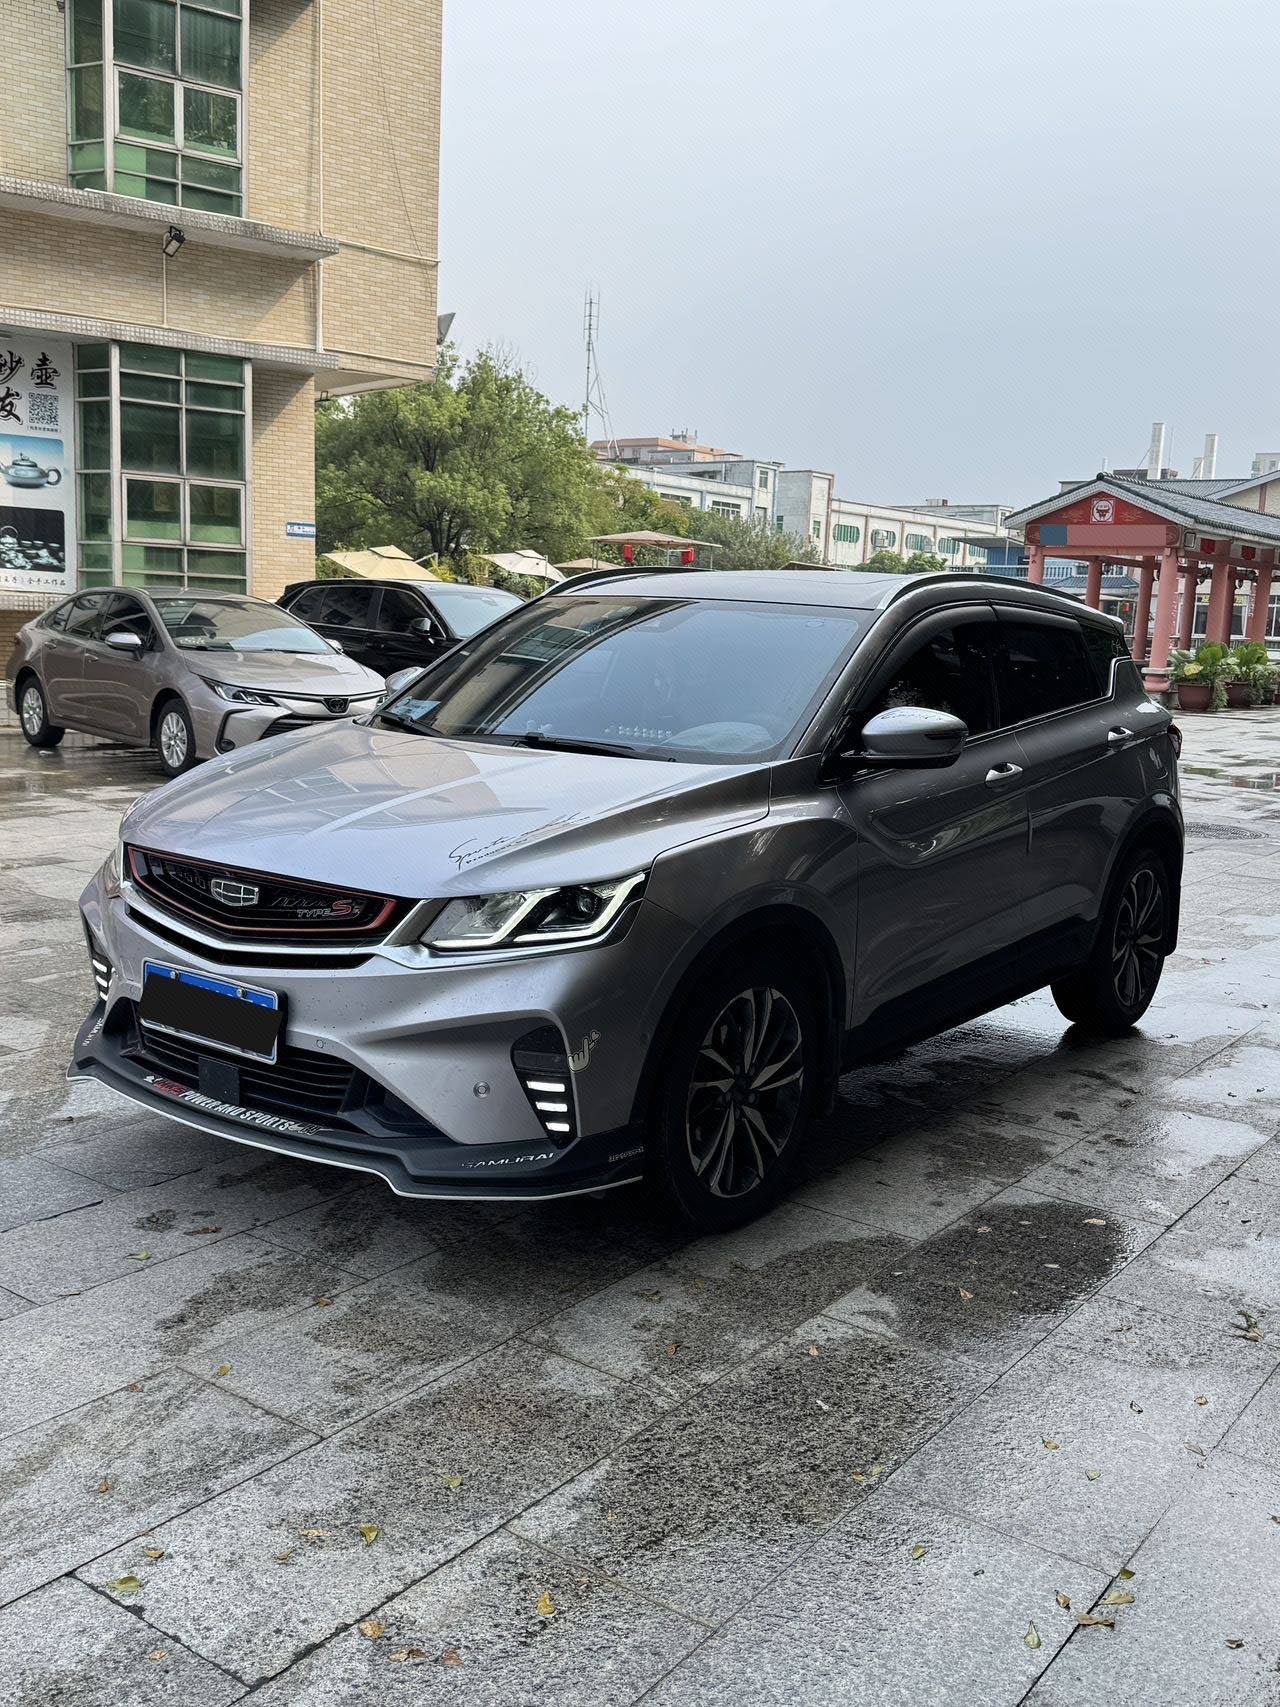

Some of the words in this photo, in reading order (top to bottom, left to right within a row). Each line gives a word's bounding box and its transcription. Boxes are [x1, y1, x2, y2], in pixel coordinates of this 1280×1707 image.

[297, 907, 331, 918] TYPE
[178, 1090, 216, 1110] POWER
[213, 1102, 245, 1117] AND
[239, 1109, 294, 1131] SPORTS
